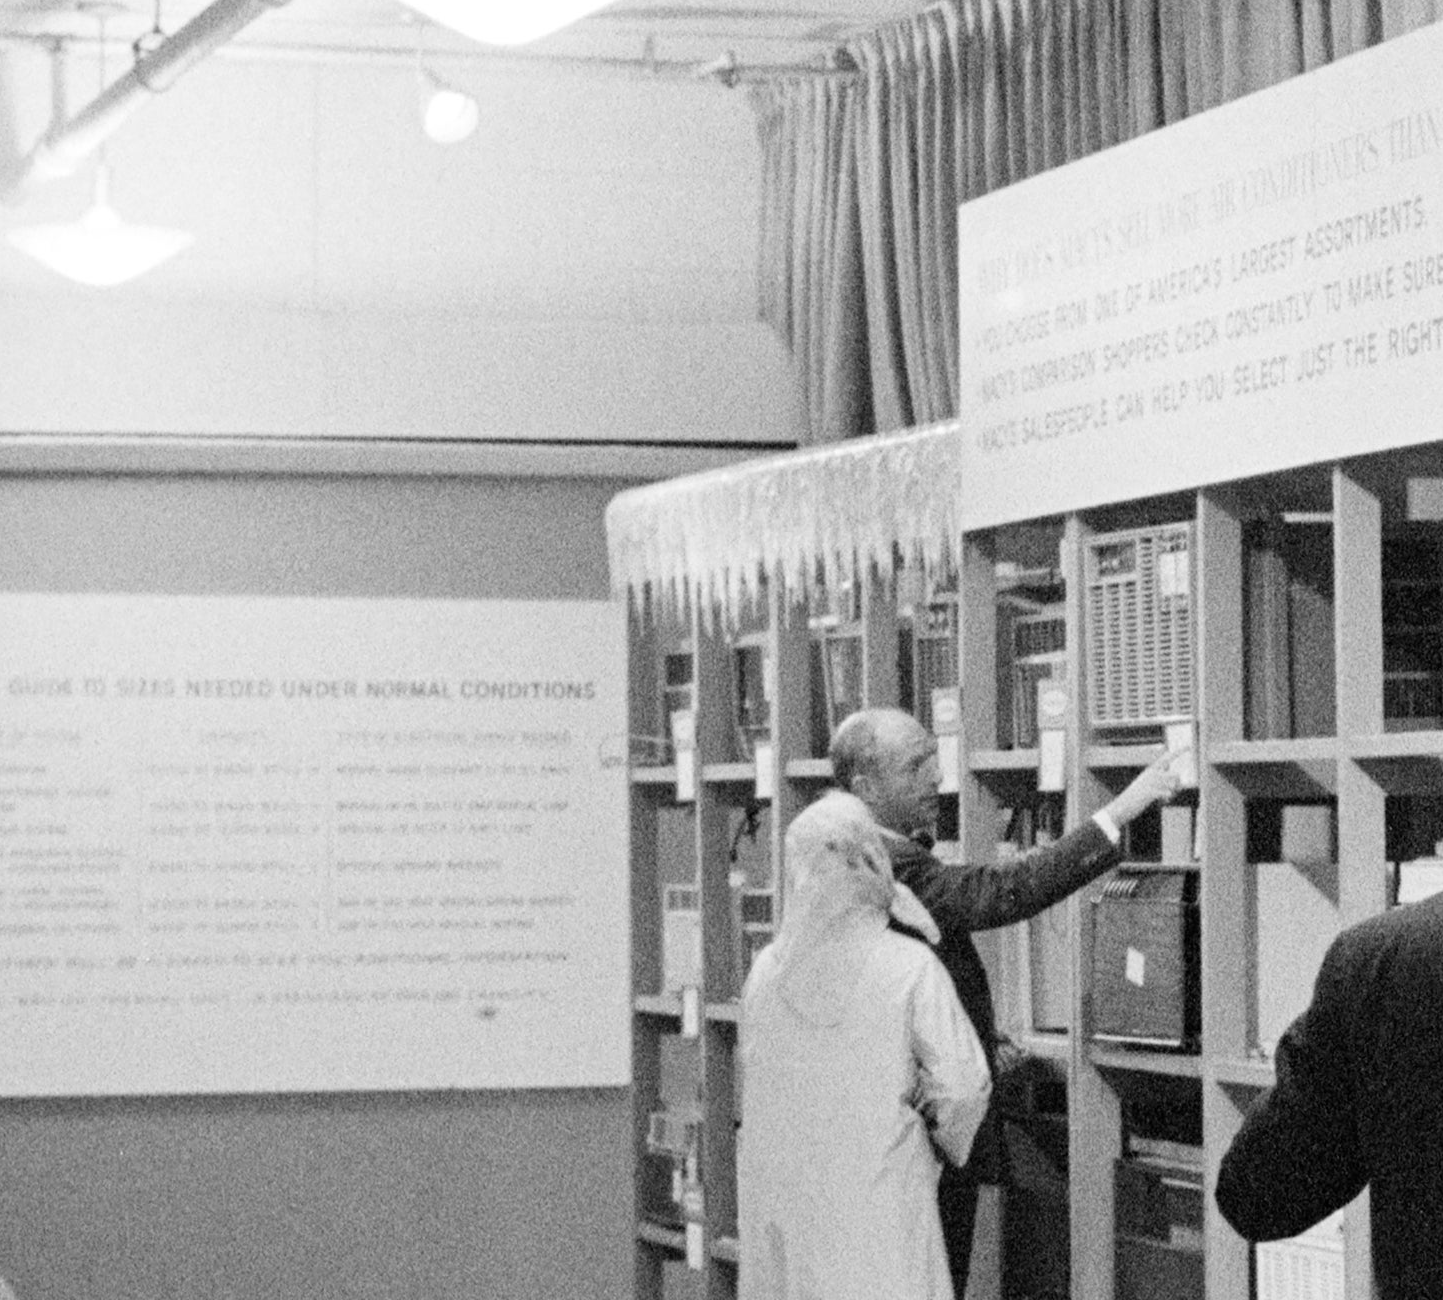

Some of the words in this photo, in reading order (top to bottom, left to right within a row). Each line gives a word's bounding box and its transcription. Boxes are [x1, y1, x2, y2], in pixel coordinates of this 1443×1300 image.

[1241, 124, 1381, 211] CONDITIONERS
[1054, 297, 1088, 333] FROM
[1094, 288, 1119, 324] ONE
[1124, 282, 1142, 314] OF
[1148, 256, 1223, 307] AMERICA'S
[1229, 235, 1297, 284] LARGEST
[1304, 194, 1429, 262] ASSORTMENTS.
[1020, 348, 1097, 394] COMPARISON
[1102, 328, 1170, 373] SHOPPERS
[1174, 316, 1220, 355] CHECK
[1224, 290, 1315, 341] CONSTANTLY
[1322, 280, 1344, 315] TO
[1347, 265, 1396, 308] MAKE
[1022, 397, 1108, 447] SALESPEOPLE
[1114, 389, 1145, 424] CAN
[1151, 378, 1190, 413] HELP
[1194, 368, 1225, 404] YOU
[1232, 355, 1289, 397] SELECT
[1296, 340, 1336, 383] JUST
[1342, 331, 1378, 369] THE
[82, 676, 108, 698] TO
[115, 676, 178, 698] SIZES
[184, 677, 275, 699] NEEDED
[279, 678, 359, 700] UNDER
[364, 678, 451, 700] NORMAL
[459, 678, 598, 701] CONDITIONS
